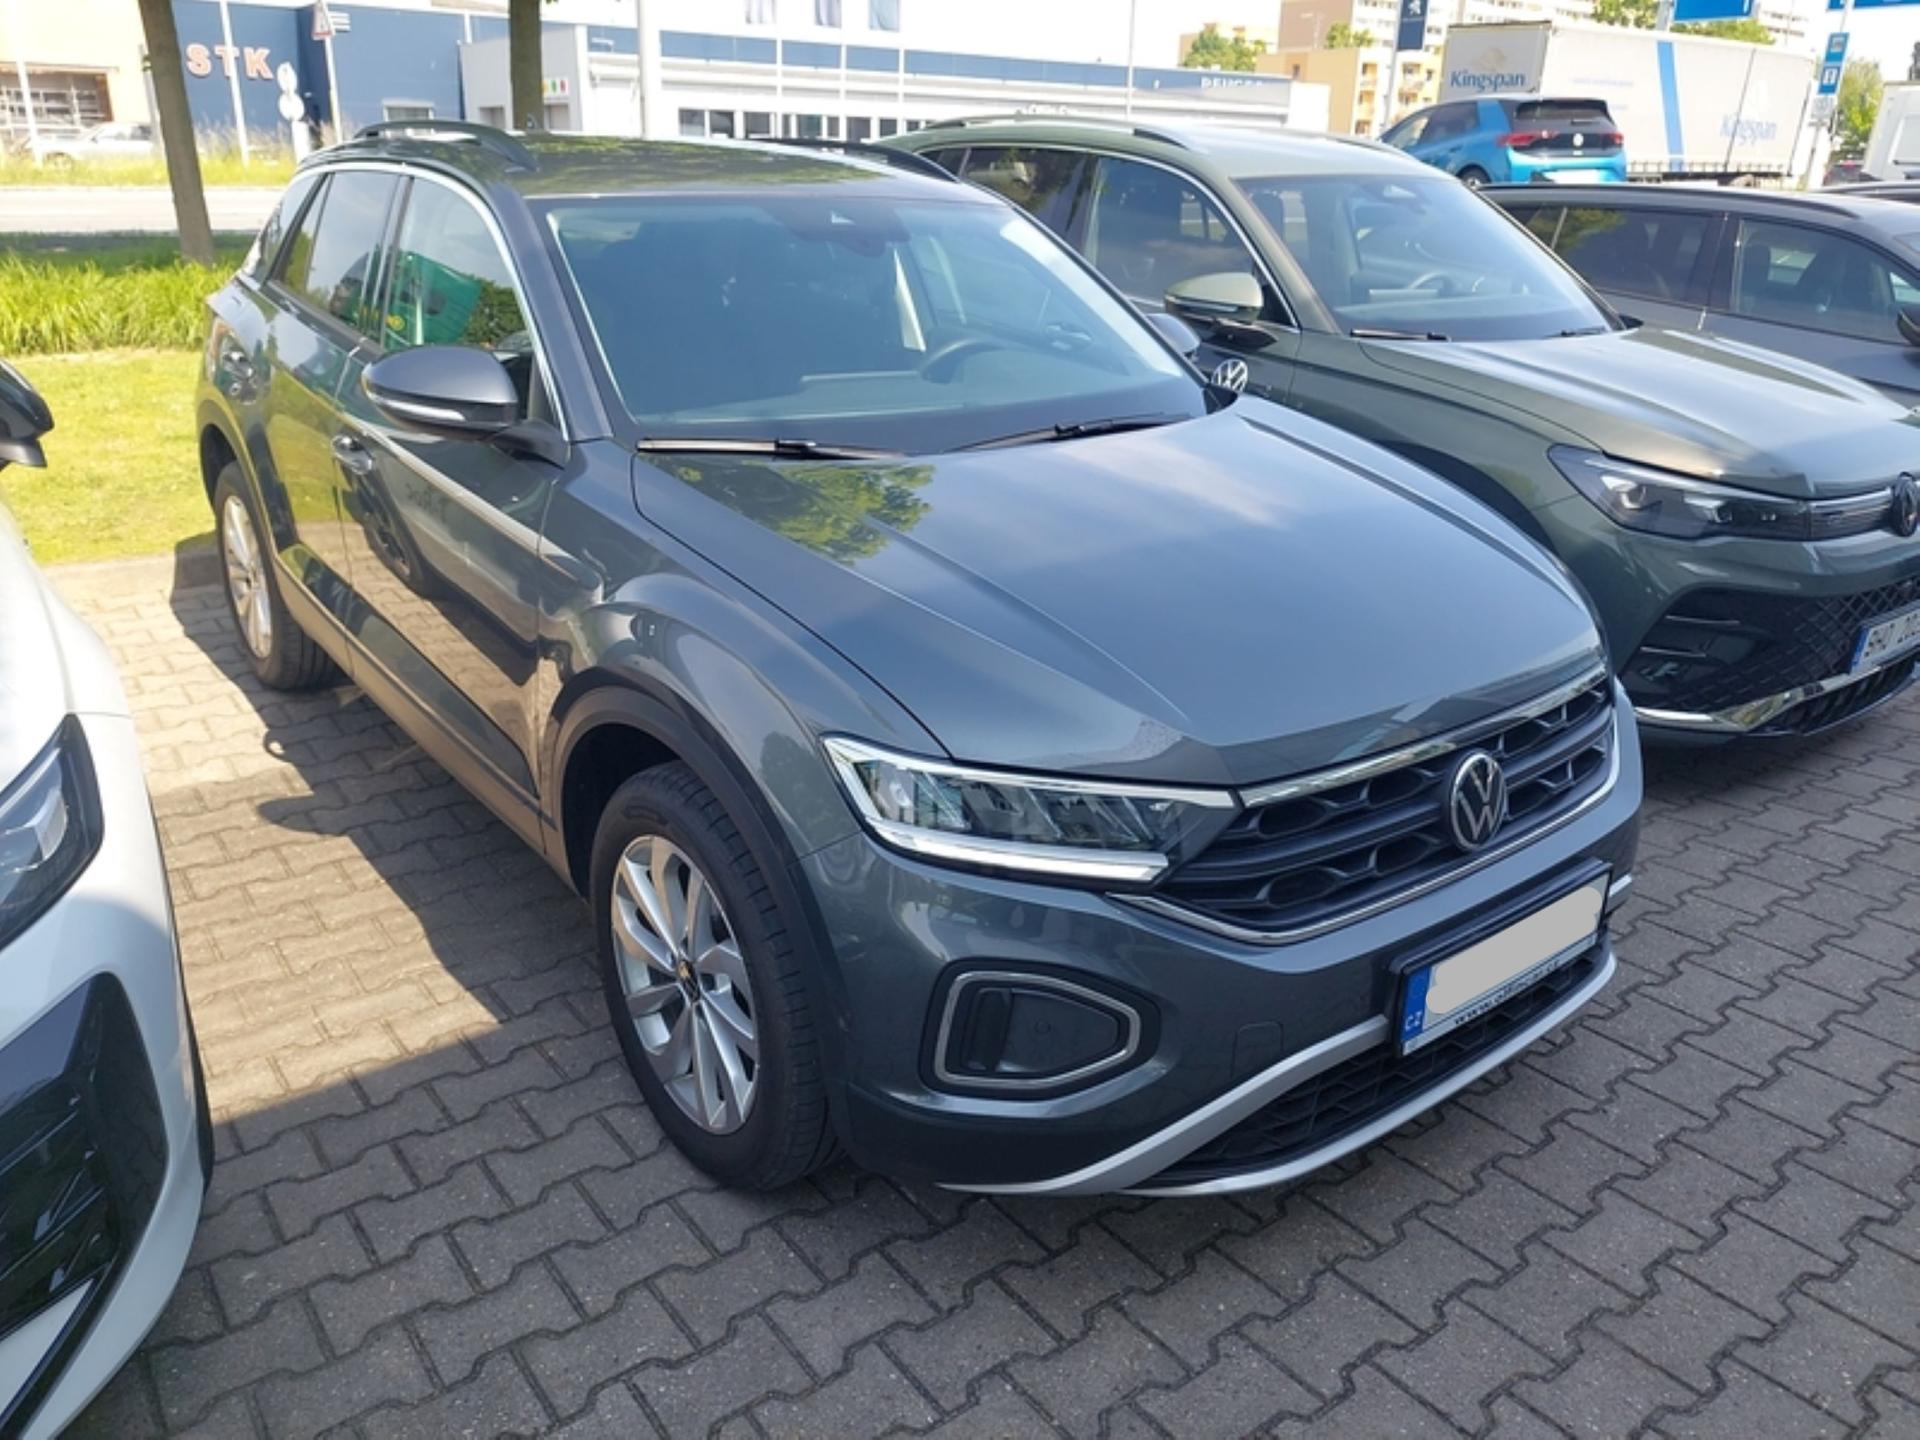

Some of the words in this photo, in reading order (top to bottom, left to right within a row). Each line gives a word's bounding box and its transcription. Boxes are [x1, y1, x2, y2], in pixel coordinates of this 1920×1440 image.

[186, 43, 274, 80] STK
[1450, 70, 1526, 93] Kingspan
[1720, 114, 1777, 146] Kngspan
[1451, 752, 1502, 848] VW
